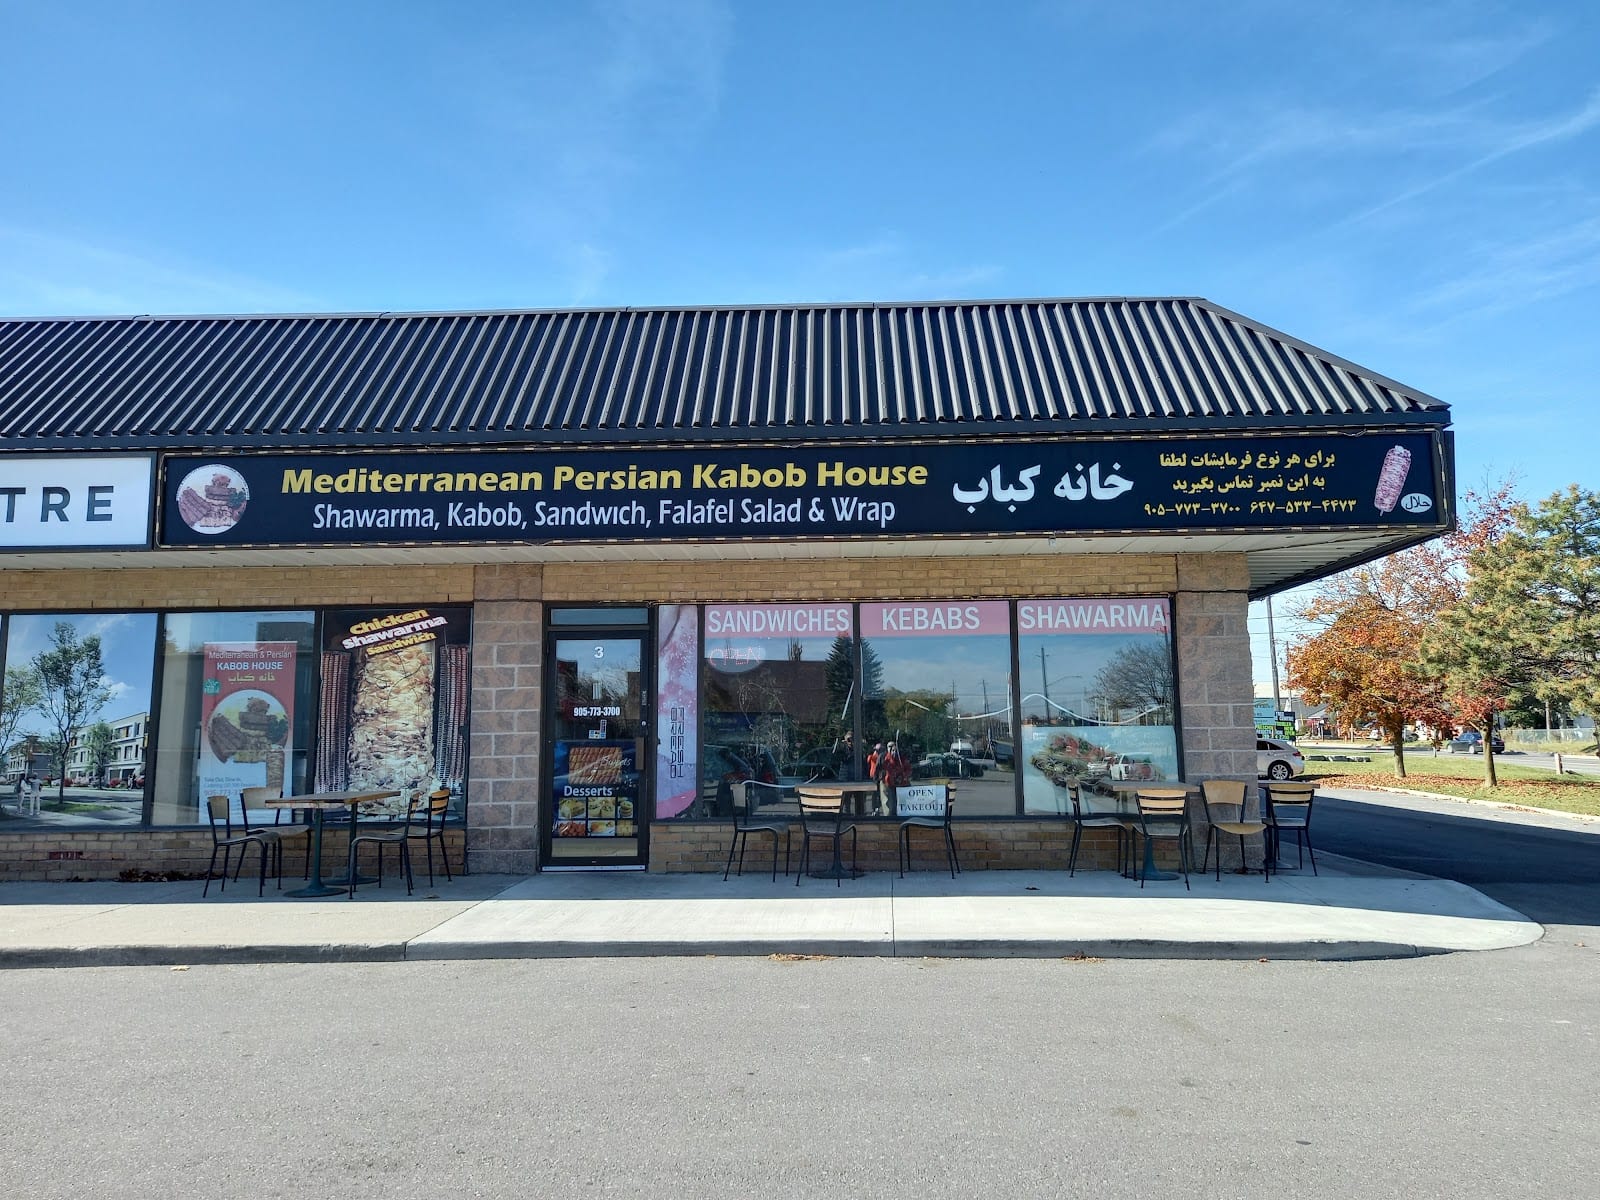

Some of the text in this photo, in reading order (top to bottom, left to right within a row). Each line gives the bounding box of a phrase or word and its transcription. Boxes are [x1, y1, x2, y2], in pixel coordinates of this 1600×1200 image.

[1159, 452, 1188, 467] لطفا
[1255, 450, 1281, 469] نوع
[1283, 453, 1302, 470] هر
[1303, 450, 1336, 468] برای
[281, 467, 543, 494] Mediterranean
[553, 464, 682, 491] Persian
[692, 462, 807, 489] Kabob
[817, 461, 928, 487] House
[1172, 473, 1326, 494] به این نمبر تماس بگیرید
[952, 462, 1135, 514] خانه کباب
[0, 485, 114, 523] TRE
[312, 496, 896, 531] Shawarma, Kabob, Sandwich, Falafel Salad & Wrap
[708, 608, 850, 633] SANDWICHES
[882, 606, 980, 631] KEBABS
[1020, 604, 1166, 630] SHAWARMA
[366, 632, 437, 655] sandwich
[594, 646, 604, 659] 3
[208, 651, 258, 659] Mediterranean
[266, 650, 292, 659] Persian
[216, 661, 284, 671] KABOB HOUSE
[573, 706, 621, 717] 905-773-3700
[677, 707, 685, 778] FRESH
[563, 785, 613, 797] Desserts
[908, 789, 934, 797] OPEN
[899, 803, 944, 811] TAKEOUT
